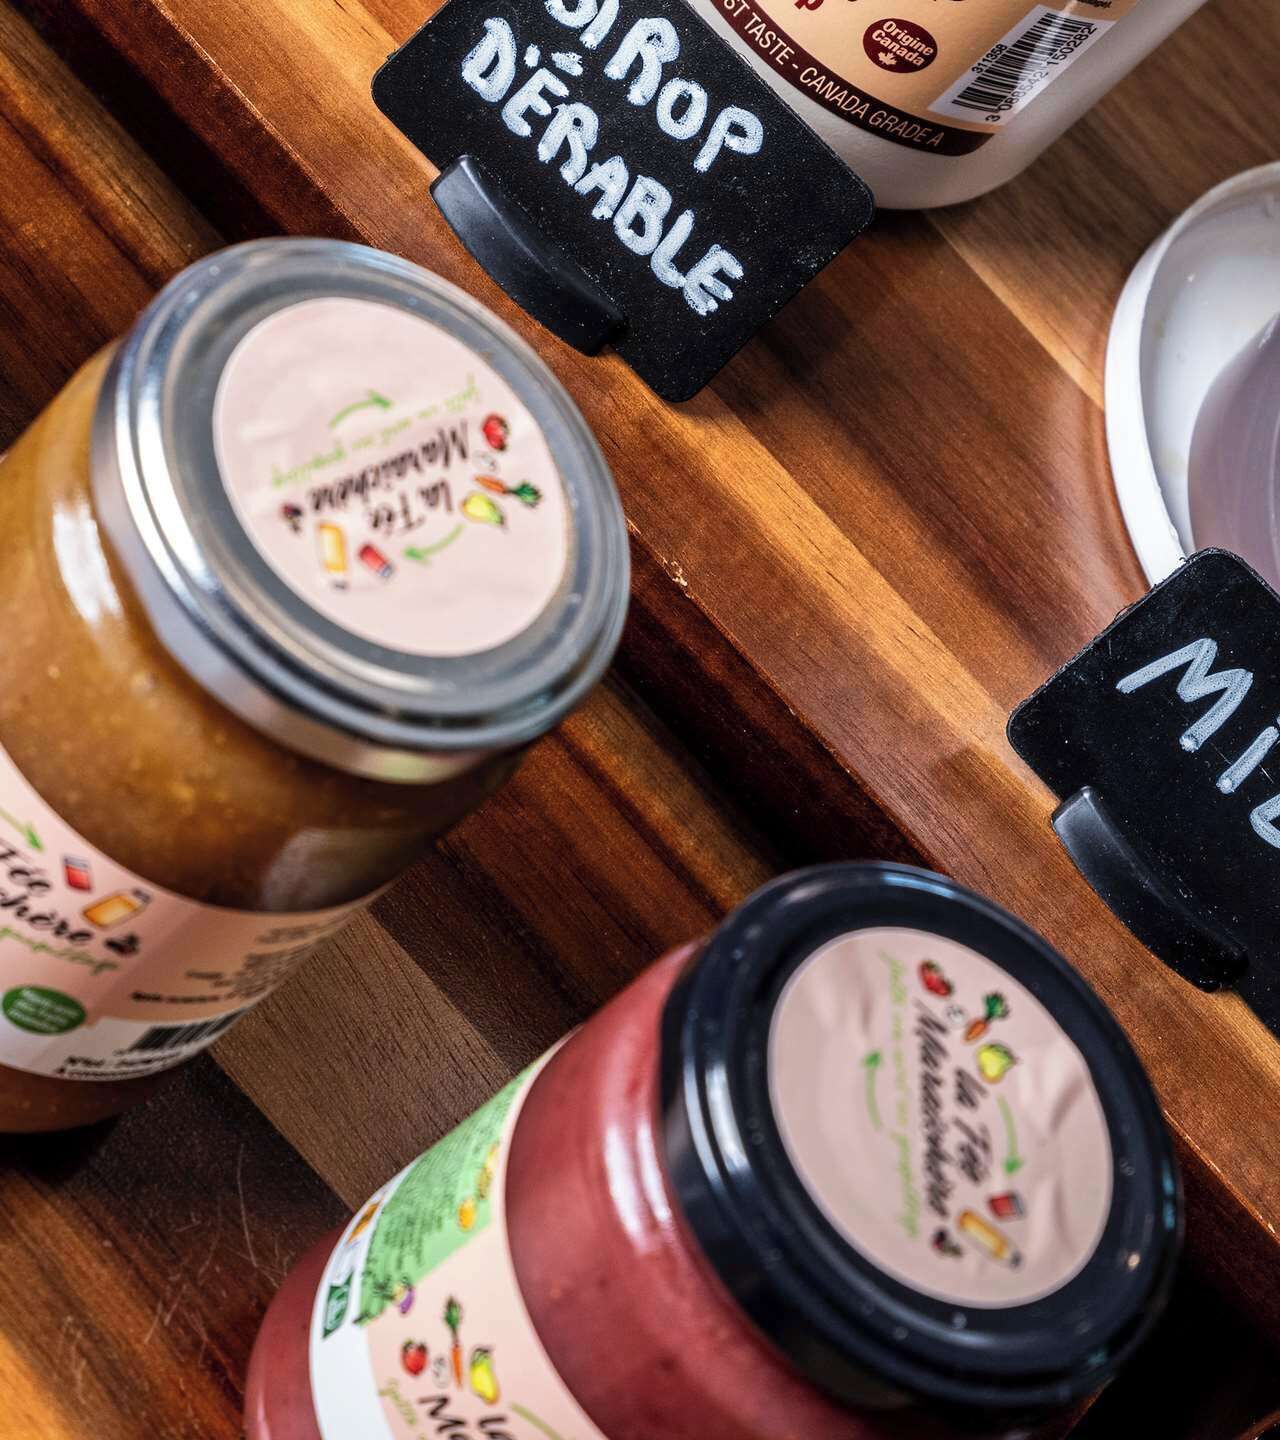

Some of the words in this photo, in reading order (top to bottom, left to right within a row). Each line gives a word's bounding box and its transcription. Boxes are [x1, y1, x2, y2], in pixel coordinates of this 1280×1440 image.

[872, 30, 925, 67] Canada
[882, 20, 934, 57] Origine
[1046, 26, 1098, 66] 150282
[971, 43, 1009, 75] 311358
[743, 12, 796, 66] TASTE
[799, 66, 871, 120] CANADA
[869, 110, 932, 140] GRADE
[926, 131, 945, 148] A
